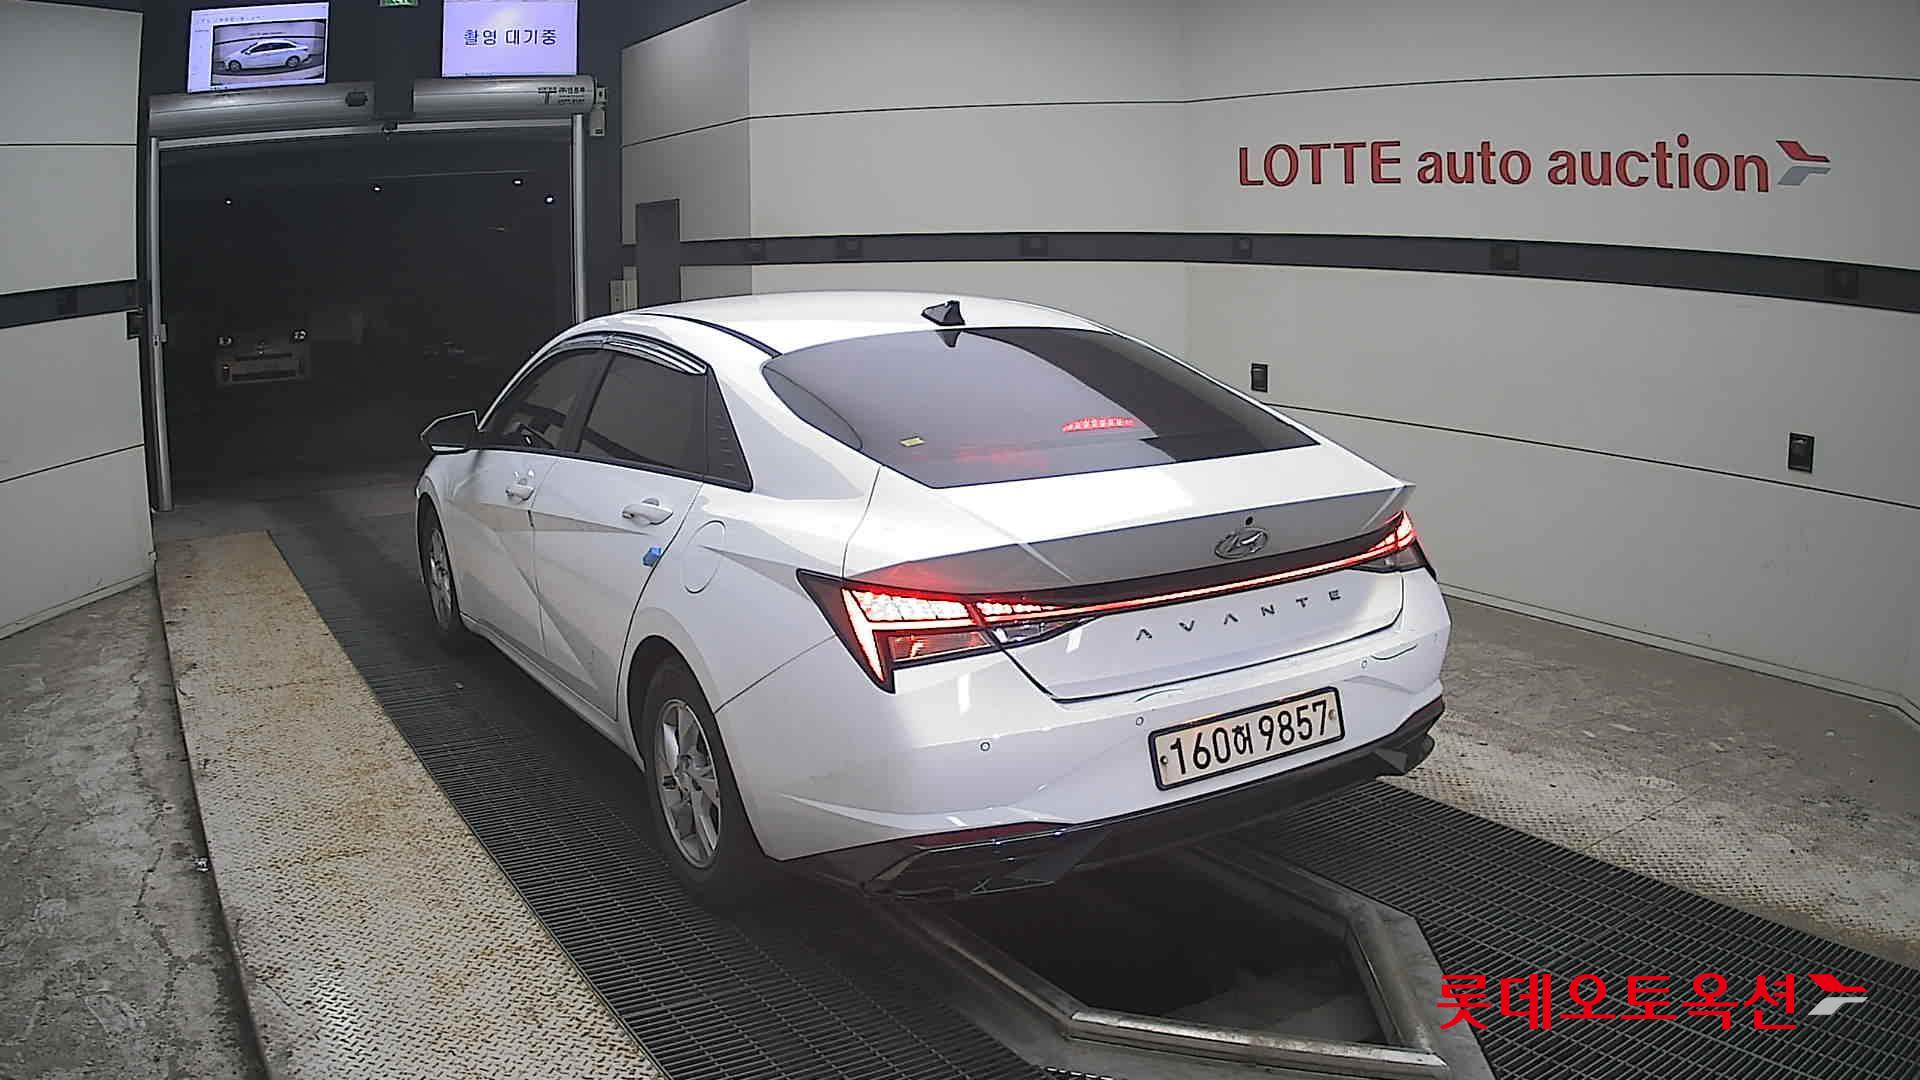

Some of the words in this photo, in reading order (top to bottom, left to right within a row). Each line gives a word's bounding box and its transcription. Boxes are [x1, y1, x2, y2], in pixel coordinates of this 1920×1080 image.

[505, 29, 557, 46] 대기중
[1239, 140, 1400, 187] LOTTE
[1418, 142, 1533, 186] auto
[1549, 134, 1770, 191] auction
[1136, 589, 1342, 641] AVANTE
